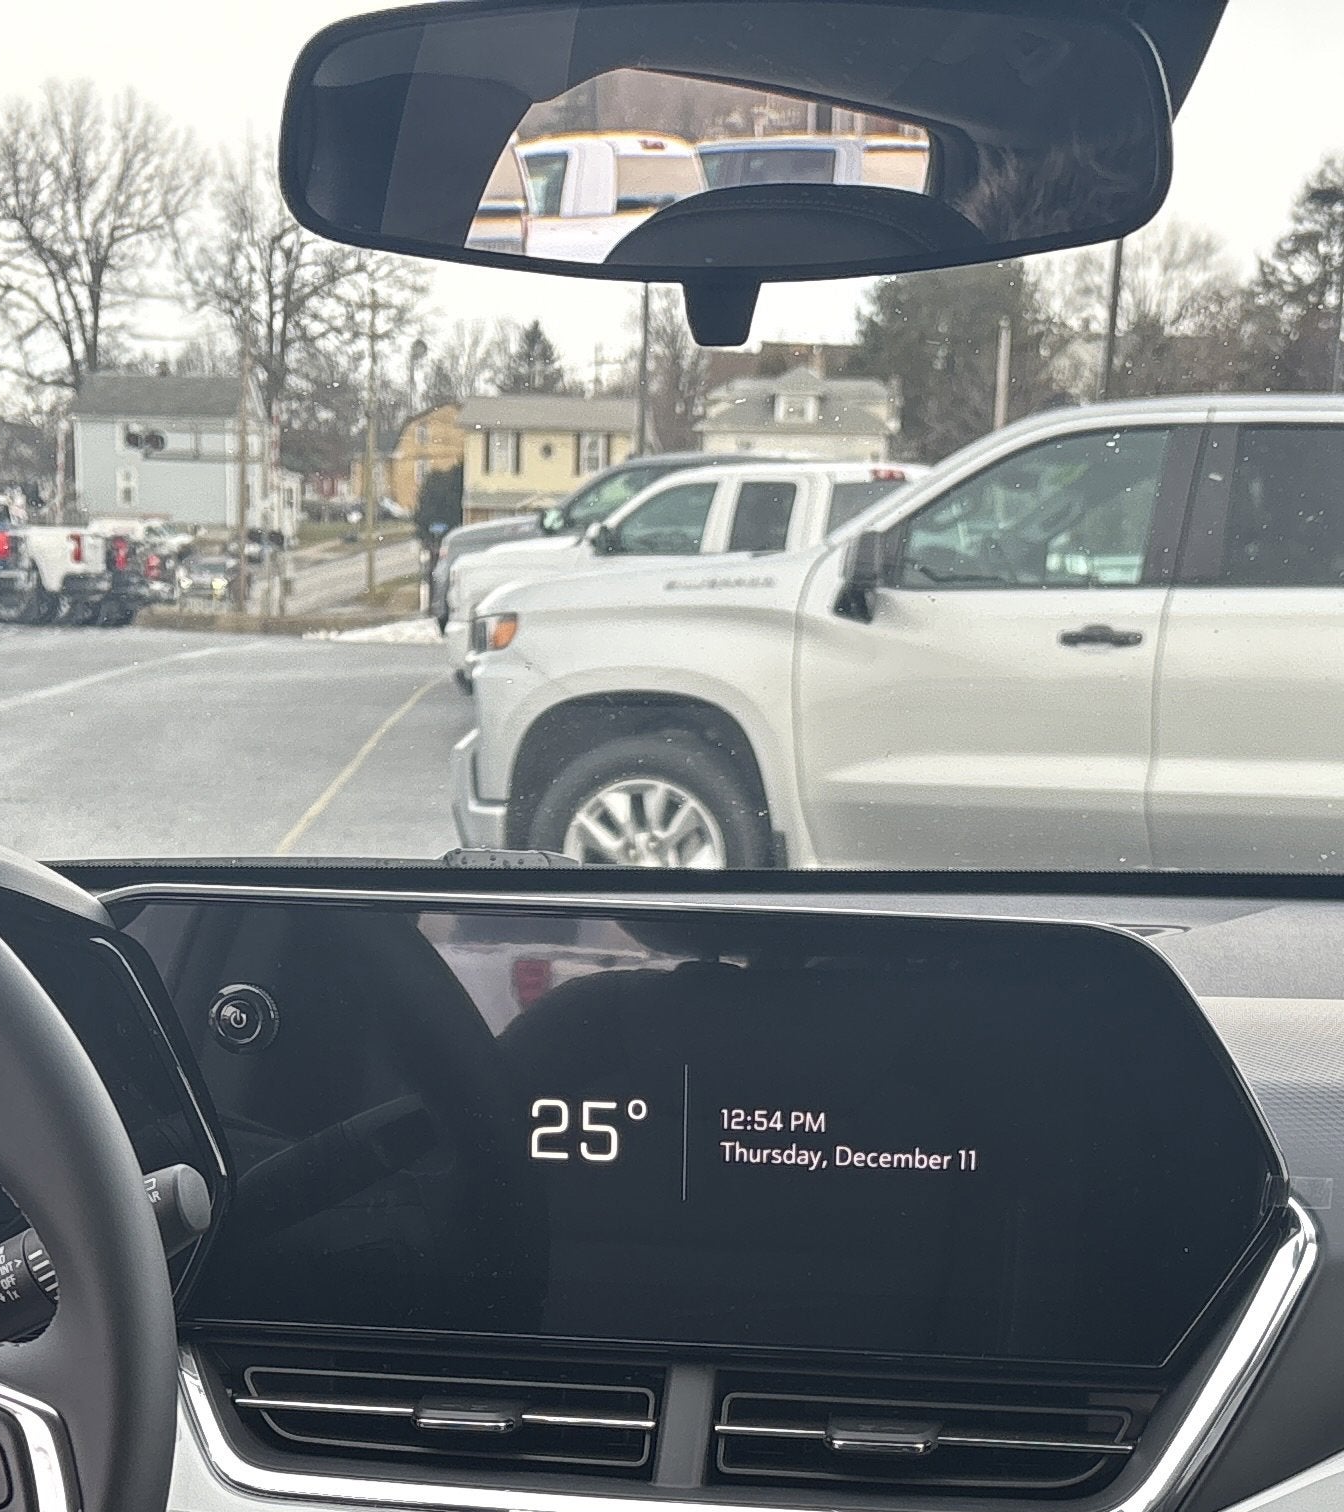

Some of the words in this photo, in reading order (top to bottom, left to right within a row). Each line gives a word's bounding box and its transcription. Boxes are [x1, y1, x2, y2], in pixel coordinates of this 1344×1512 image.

[721, 1109, 783, 1131] 12:54
[790, 1112, 826, 1133] PM
[720, 1140, 828, 1170] Thursday,
[836, 1146, 951, 1170] December
[958, 1150, 977, 1171] 11
